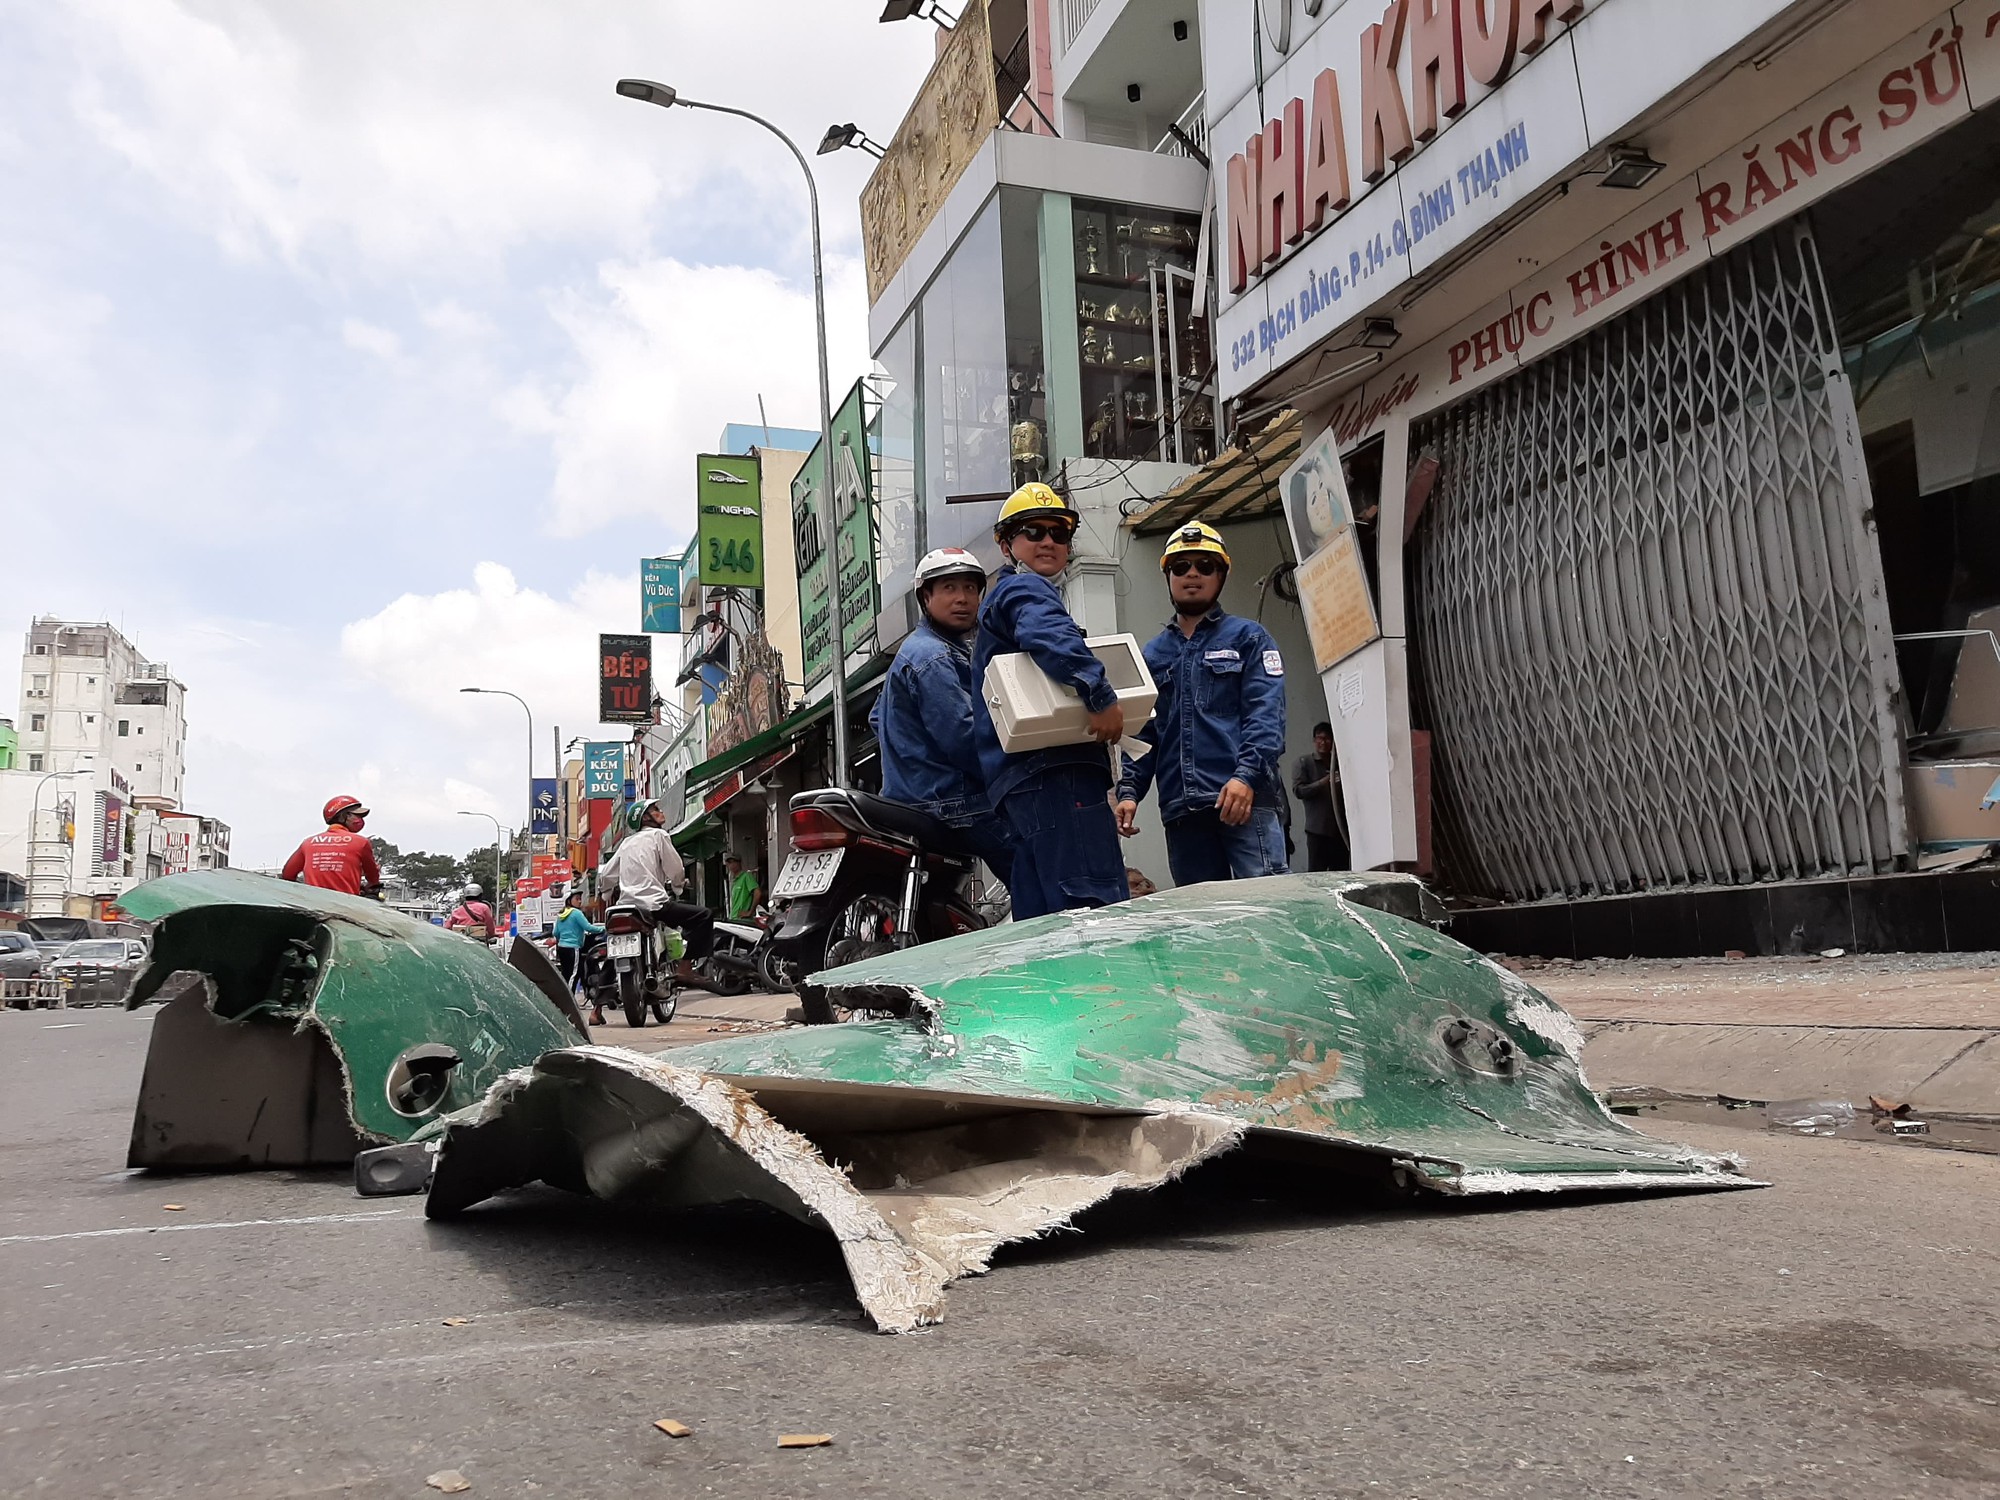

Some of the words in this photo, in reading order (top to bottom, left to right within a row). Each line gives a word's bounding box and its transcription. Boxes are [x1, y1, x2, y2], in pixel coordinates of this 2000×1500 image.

[1226, 67, 1350, 295] NHA
[1571, 208, 1690, 317] HÌNH
[1695, 105, 1862, 240] RĂNG
[1878, 25, 1963, 130] SỨ
[1231, 329, 1256, 372] 332
[1259, 298, 1296, 357] BẠCH
[1457, 121, 1530, 206] THẠNH
[708, 537, 755, 573] 346
[604, 650, 649, 678] BẾP
[610, 682, 642, 709] TỪ
[591, 781, 618, 793] ĐỨC
[595, 769, 613, 781] VŨ
[532, 807, 560, 823] PNJ
[166, 849, 187, 863] KHOA
